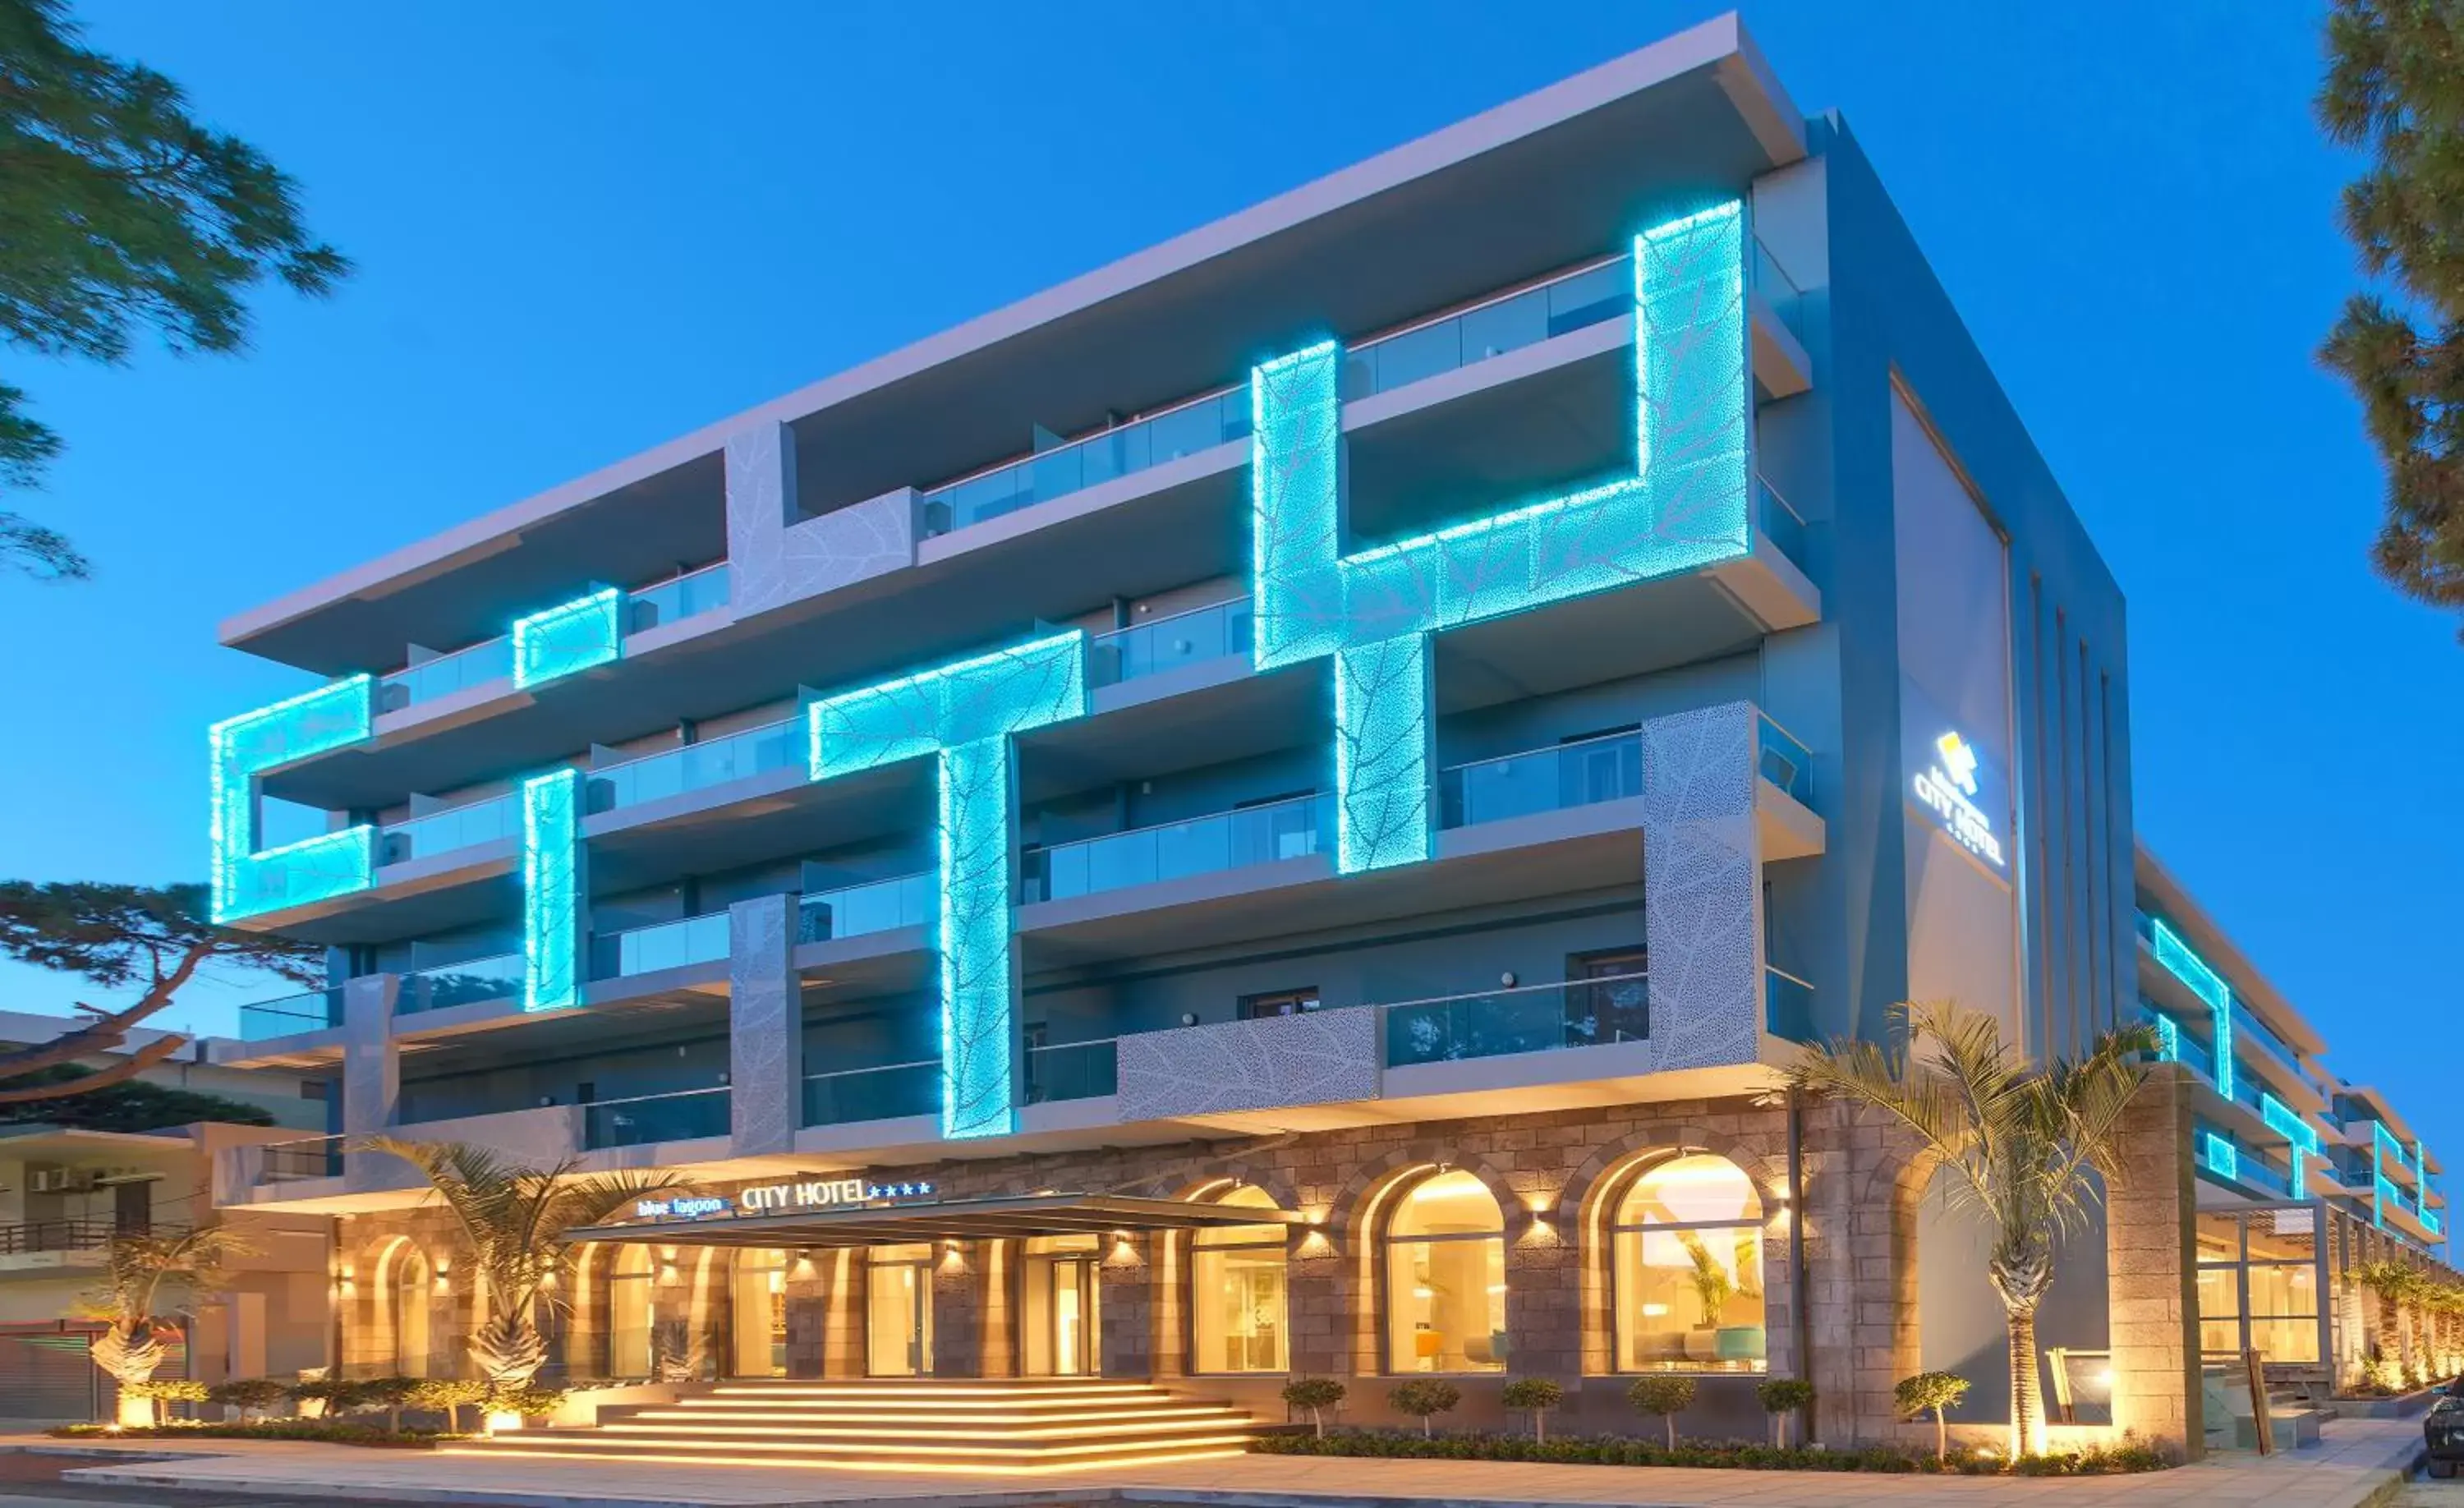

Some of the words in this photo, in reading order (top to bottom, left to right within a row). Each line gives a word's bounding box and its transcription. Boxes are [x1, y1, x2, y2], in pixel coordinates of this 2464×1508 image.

[742, 1186, 788, 1209] CITY
[797, 1179, 871, 1206] HOTEL
[637, 1202, 667, 1217] blue
[673, 1198, 720, 1216] lagoon
